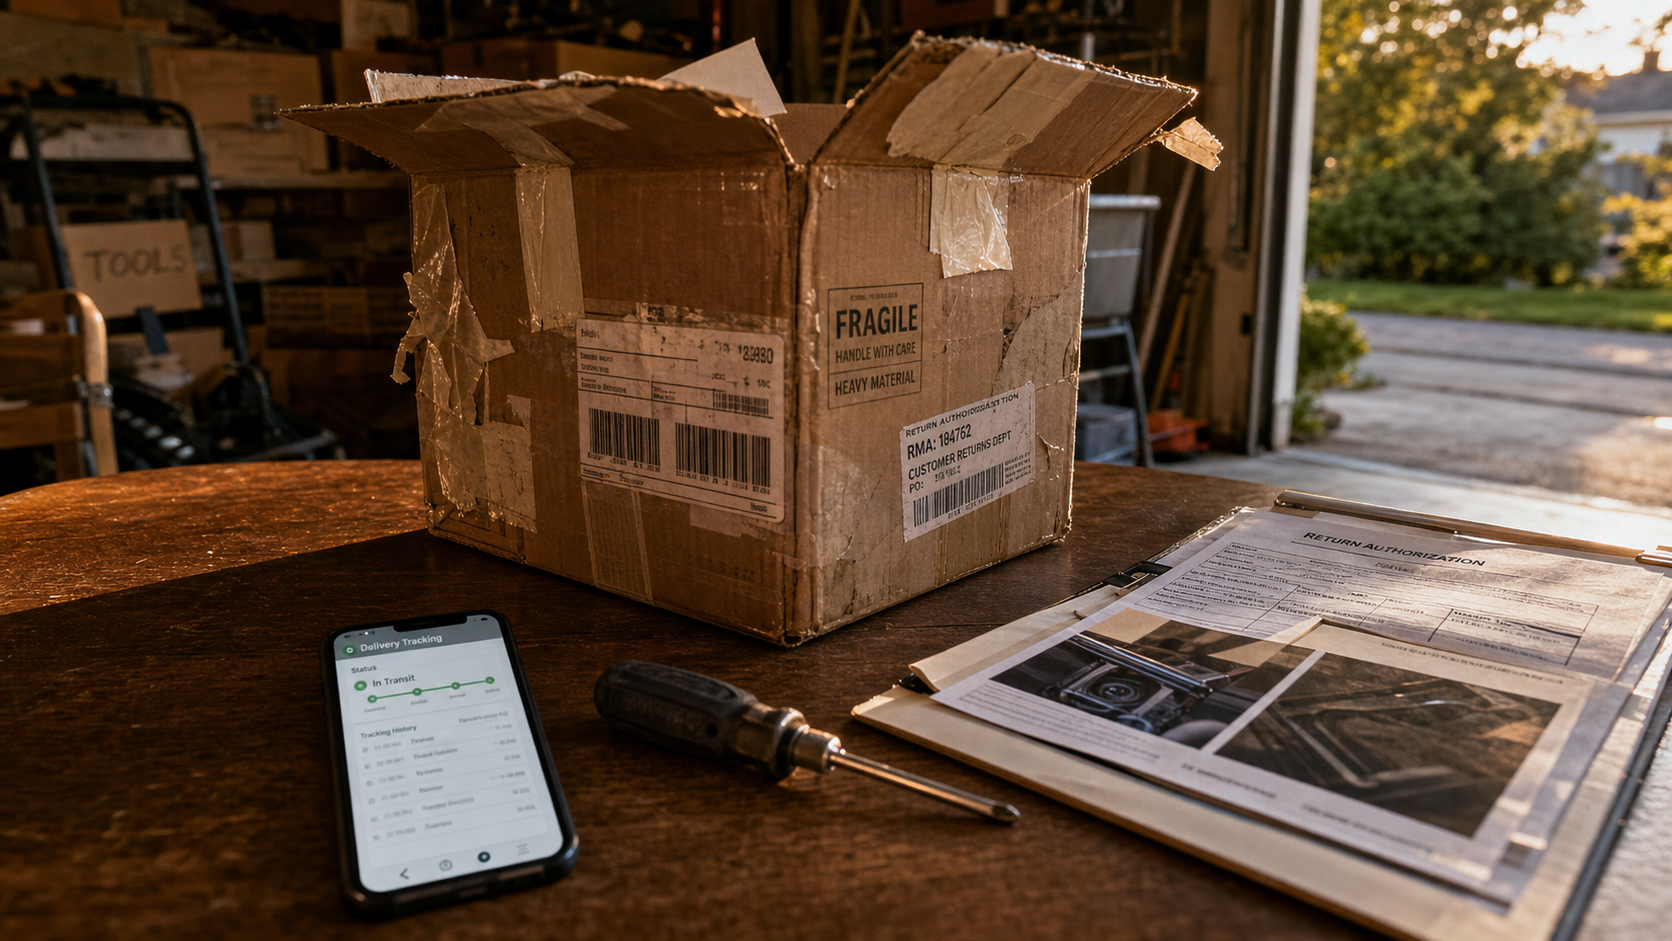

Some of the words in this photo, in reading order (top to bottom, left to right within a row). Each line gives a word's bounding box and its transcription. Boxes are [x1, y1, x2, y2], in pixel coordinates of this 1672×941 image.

[82, 244, 189, 282] TOOLS
[836, 304, 918, 339] FRAGILE
[835, 347, 871, 364] HANDLE
[873, 344, 894, 359] WITH
[896, 341, 916, 356] CARE
[835, 377, 868, 396] HEAVY
[870, 370, 916, 390] MATERIAL
[905, 420, 938, 438] RETURN
[907, 438, 937, 460] RMA:
[938, 424, 972, 447] 184762
[908, 453, 956, 480] CUSTOMER
[957, 438, 991, 461] RETURNS
[992, 430, 1012, 447] DEPT
[909, 481, 924, 494] PO:
[1303, 531, 1362, 548] RETURN
[1362, 542, 1486, 567] AUTHORIZATION
[401, 635, 443, 646] Tracking
[351, 665, 377, 674] Status
[383, 674, 416, 685] Transit
[361, 730, 392, 739] Tracking
[391, 726, 417, 734] History
